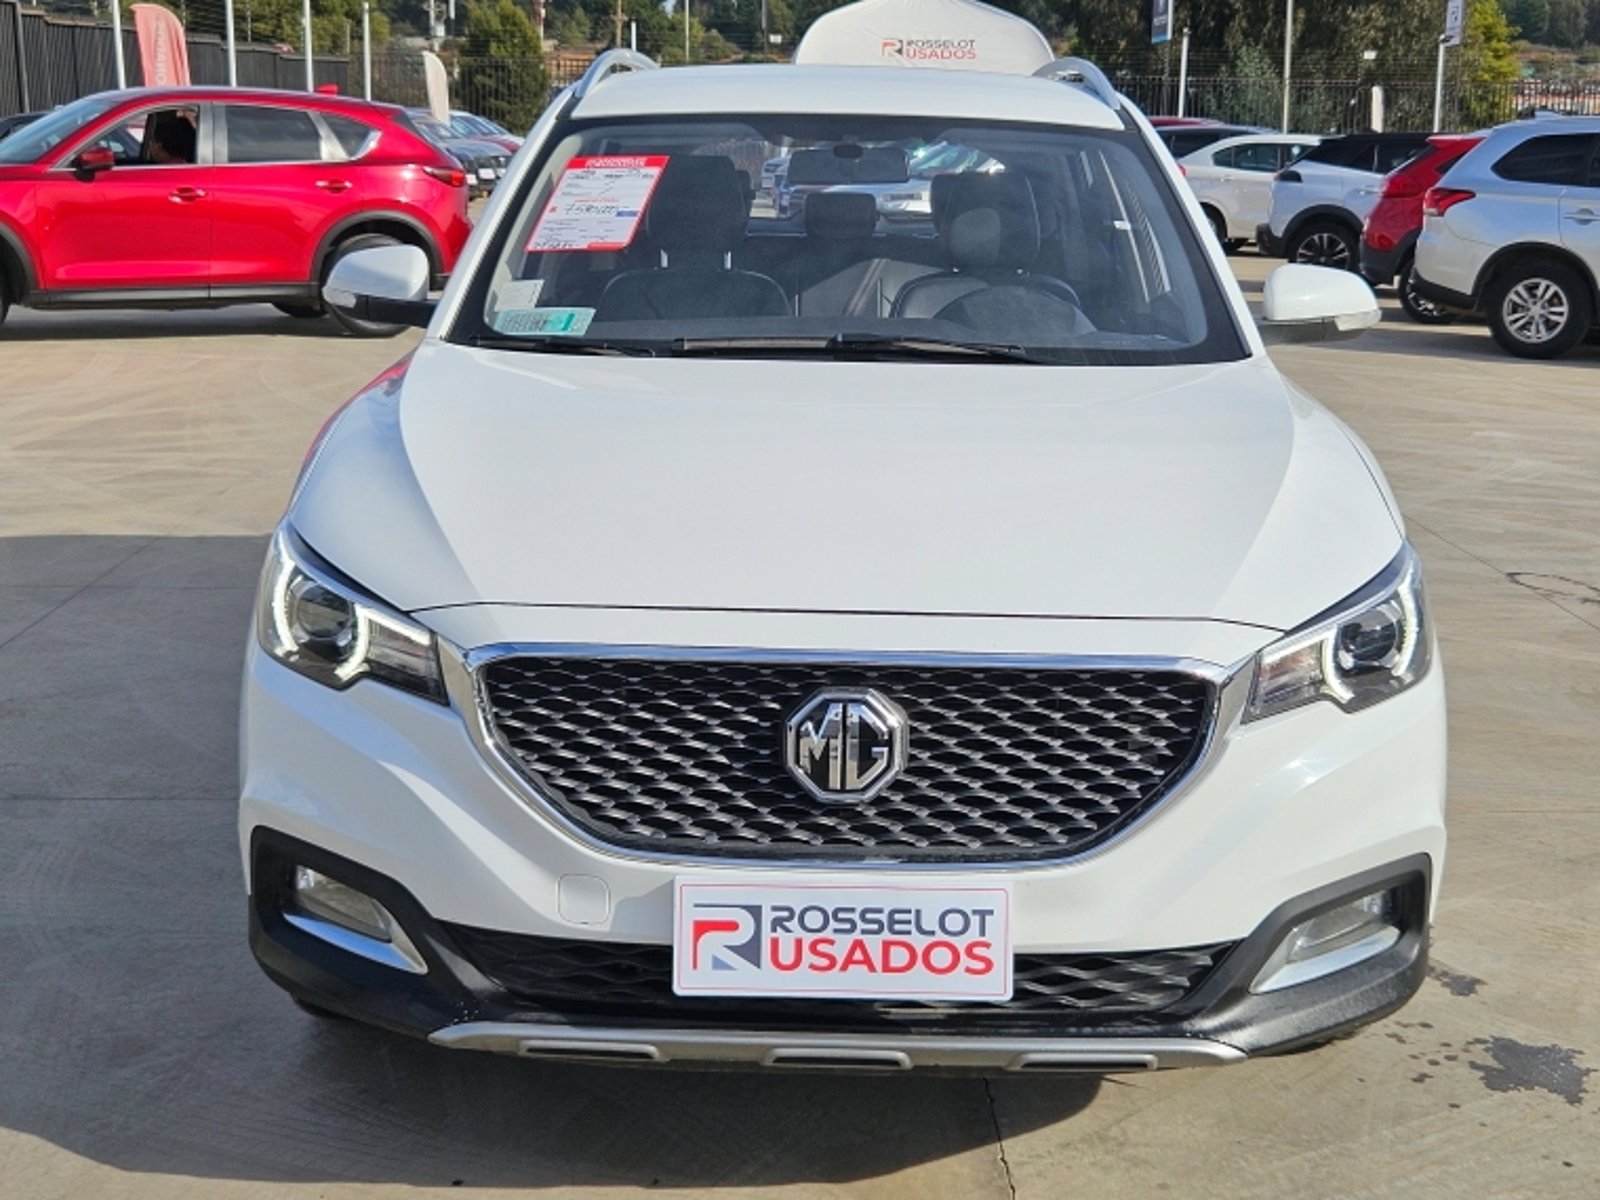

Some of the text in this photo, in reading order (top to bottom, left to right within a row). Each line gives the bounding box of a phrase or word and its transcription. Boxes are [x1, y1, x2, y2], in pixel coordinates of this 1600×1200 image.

[905, 48, 977, 60] USADOS
[906, 39, 975, 49] ROSSELOT
[800, 702, 889, 790] MG
[770, 904, 995, 937] ROSSELOT
[769, 936, 995, 976] USADOS
